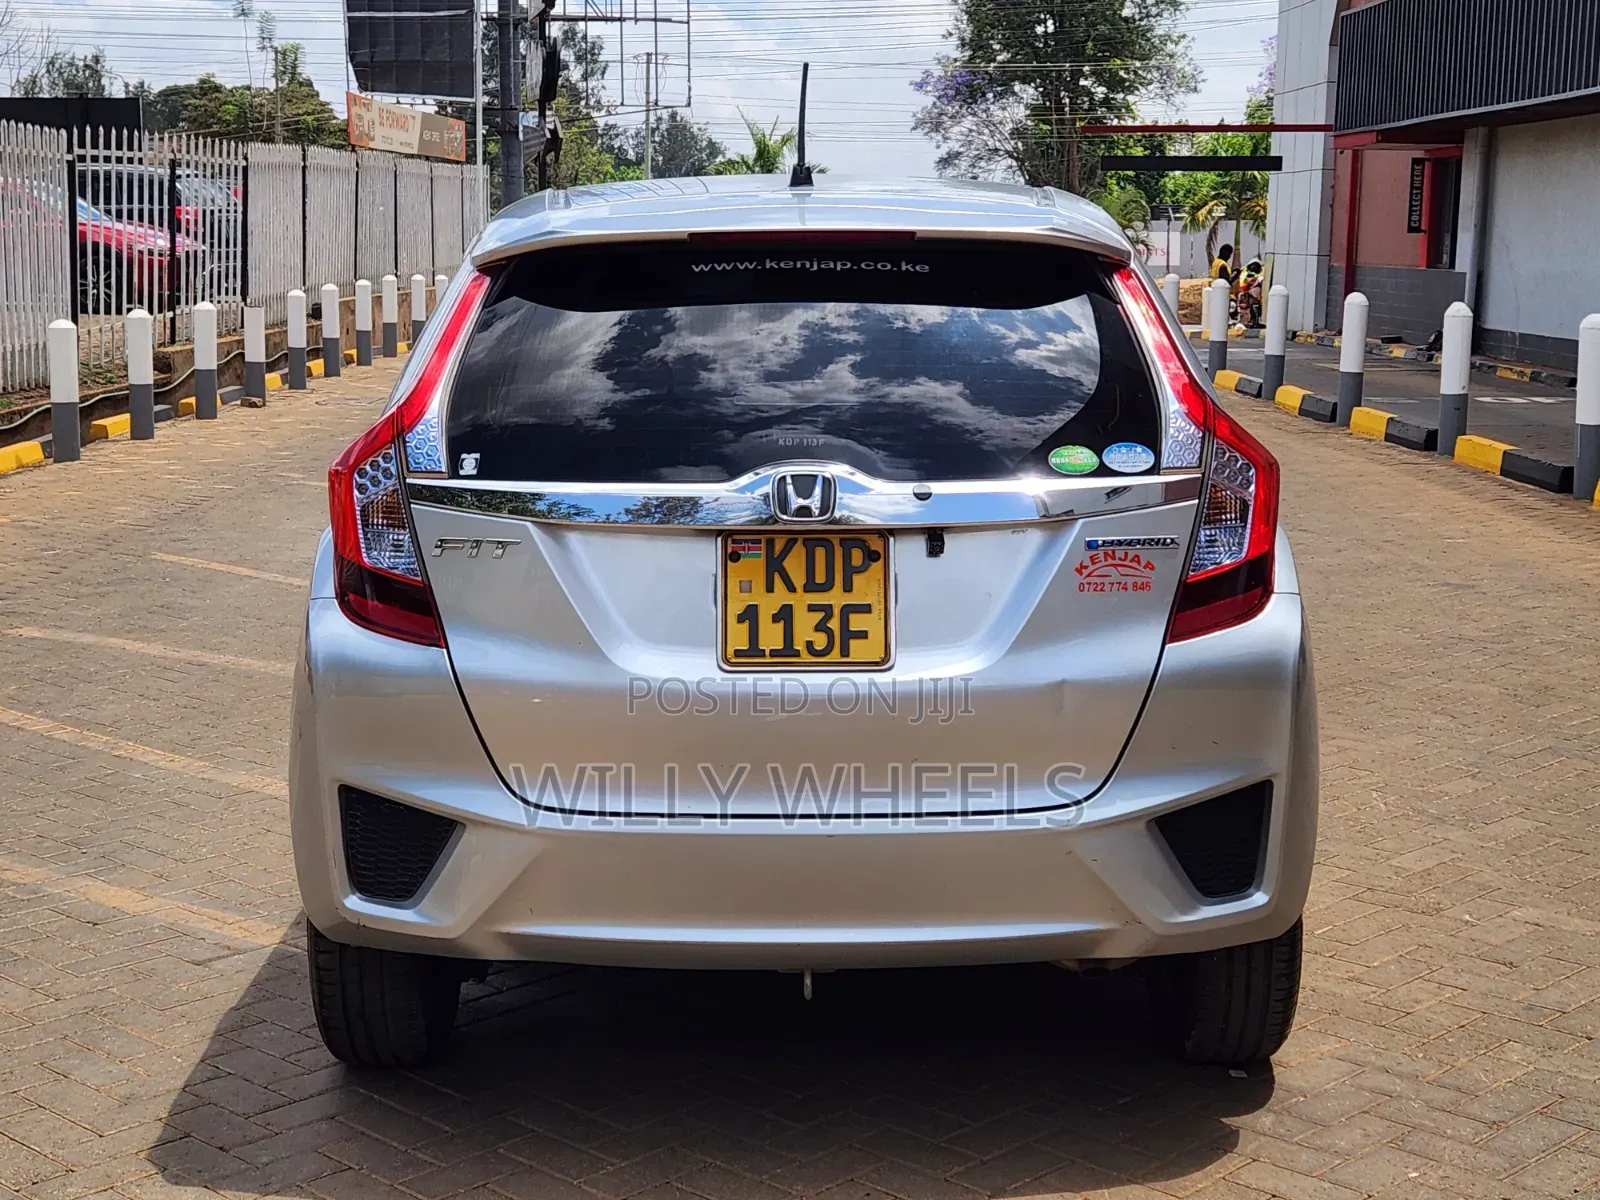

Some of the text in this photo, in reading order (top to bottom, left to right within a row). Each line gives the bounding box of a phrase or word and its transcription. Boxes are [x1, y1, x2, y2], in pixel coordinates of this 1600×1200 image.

[1410, 164, 1423, 227] COLLECT HERE
[691, 258, 930, 272] www.kenjap.co.ke
[778, 437, 825, 447] KDP 113F
[431, 536, 522, 559] FIT
[1100, 536, 1179, 548] HYBRID
[765, 537, 872, 593] KDP
[1074, 549, 1156, 576] KENJAP
[1078, 582, 1106, 592] 0722
[1108, 581, 1129, 592] 774
[733, 603, 872, 657] 113F
